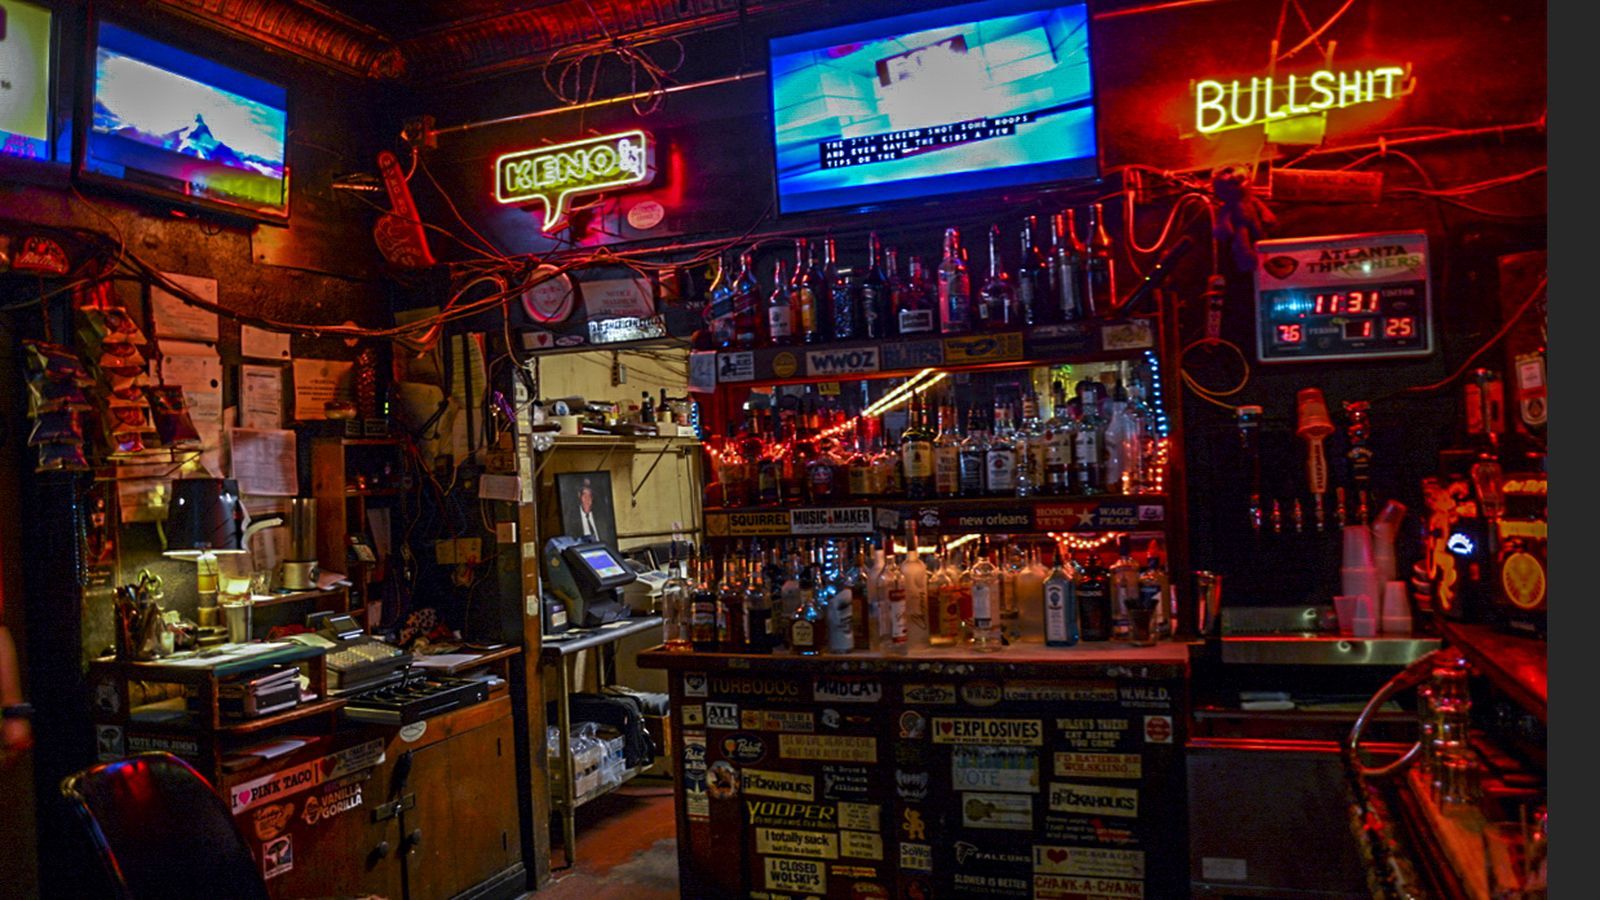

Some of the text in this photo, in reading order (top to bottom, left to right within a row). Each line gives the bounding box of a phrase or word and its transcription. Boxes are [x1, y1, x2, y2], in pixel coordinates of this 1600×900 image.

[1195, 67, 1404, 133] BULLSHIT
[826, 141, 844, 150] THE
[882, 130, 920, 141] LEGEND
[928, 124, 953, 135] SHOT
[961, 120, 987, 131] SOME
[994, 115, 1029, 125] HOOPS
[826, 127, 1009, 159] AND EVEN GAVE THE KIDS A FEW
[505, 145, 617, 192] KENO
[826, 152, 896, 168] TIPS ON THE
[1318, 245, 1409, 260] ATLANTA
[1306, 256, 1421, 275] THRASHERS
[1314, 290, 1380, 314] 11:31
[1362, 320, 1372, 338] 1
[1385, 317, 1413, 337] 25
[811, 351, 875, 370] WWOZ
[730, 512, 789, 526] SQUIRREL
[793, 509, 870, 524] MUSIC MAKER
[959, 513, 1029, 527] new orleans
[1035, 507, 1074, 517] HONOR
[1098, 507, 1132, 516] WAGE
[1098, 516, 1139, 526] PEACE
[710, 678, 800, 697] TURBODOG
[816, 680, 879, 696] MUDCAT
[1120, 687, 1172, 701] W.W.E.D.
[708, 706, 737, 718] ATL
[935, 720, 1039, 738] I EXPLOSIVES
[231, 794, 239, 808] I
[251, 780, 281, 802] PINK
[282, 768, 313, 787] TACO
[320, 783, 363, 806] VANILLA
[321, 793, 364, 819] GORILLA
[745, 800, 836, 825] YOOPER
[765, 830, 830, 846] I totally suck
[975, 851, 1032, 863] FALCONS
[772, 860, 816, 874] I CLOSED
[771, 871, 820, 885] WOLSKI'S
[1035, 877, 1140, 894] CHANK-A-CHANK
